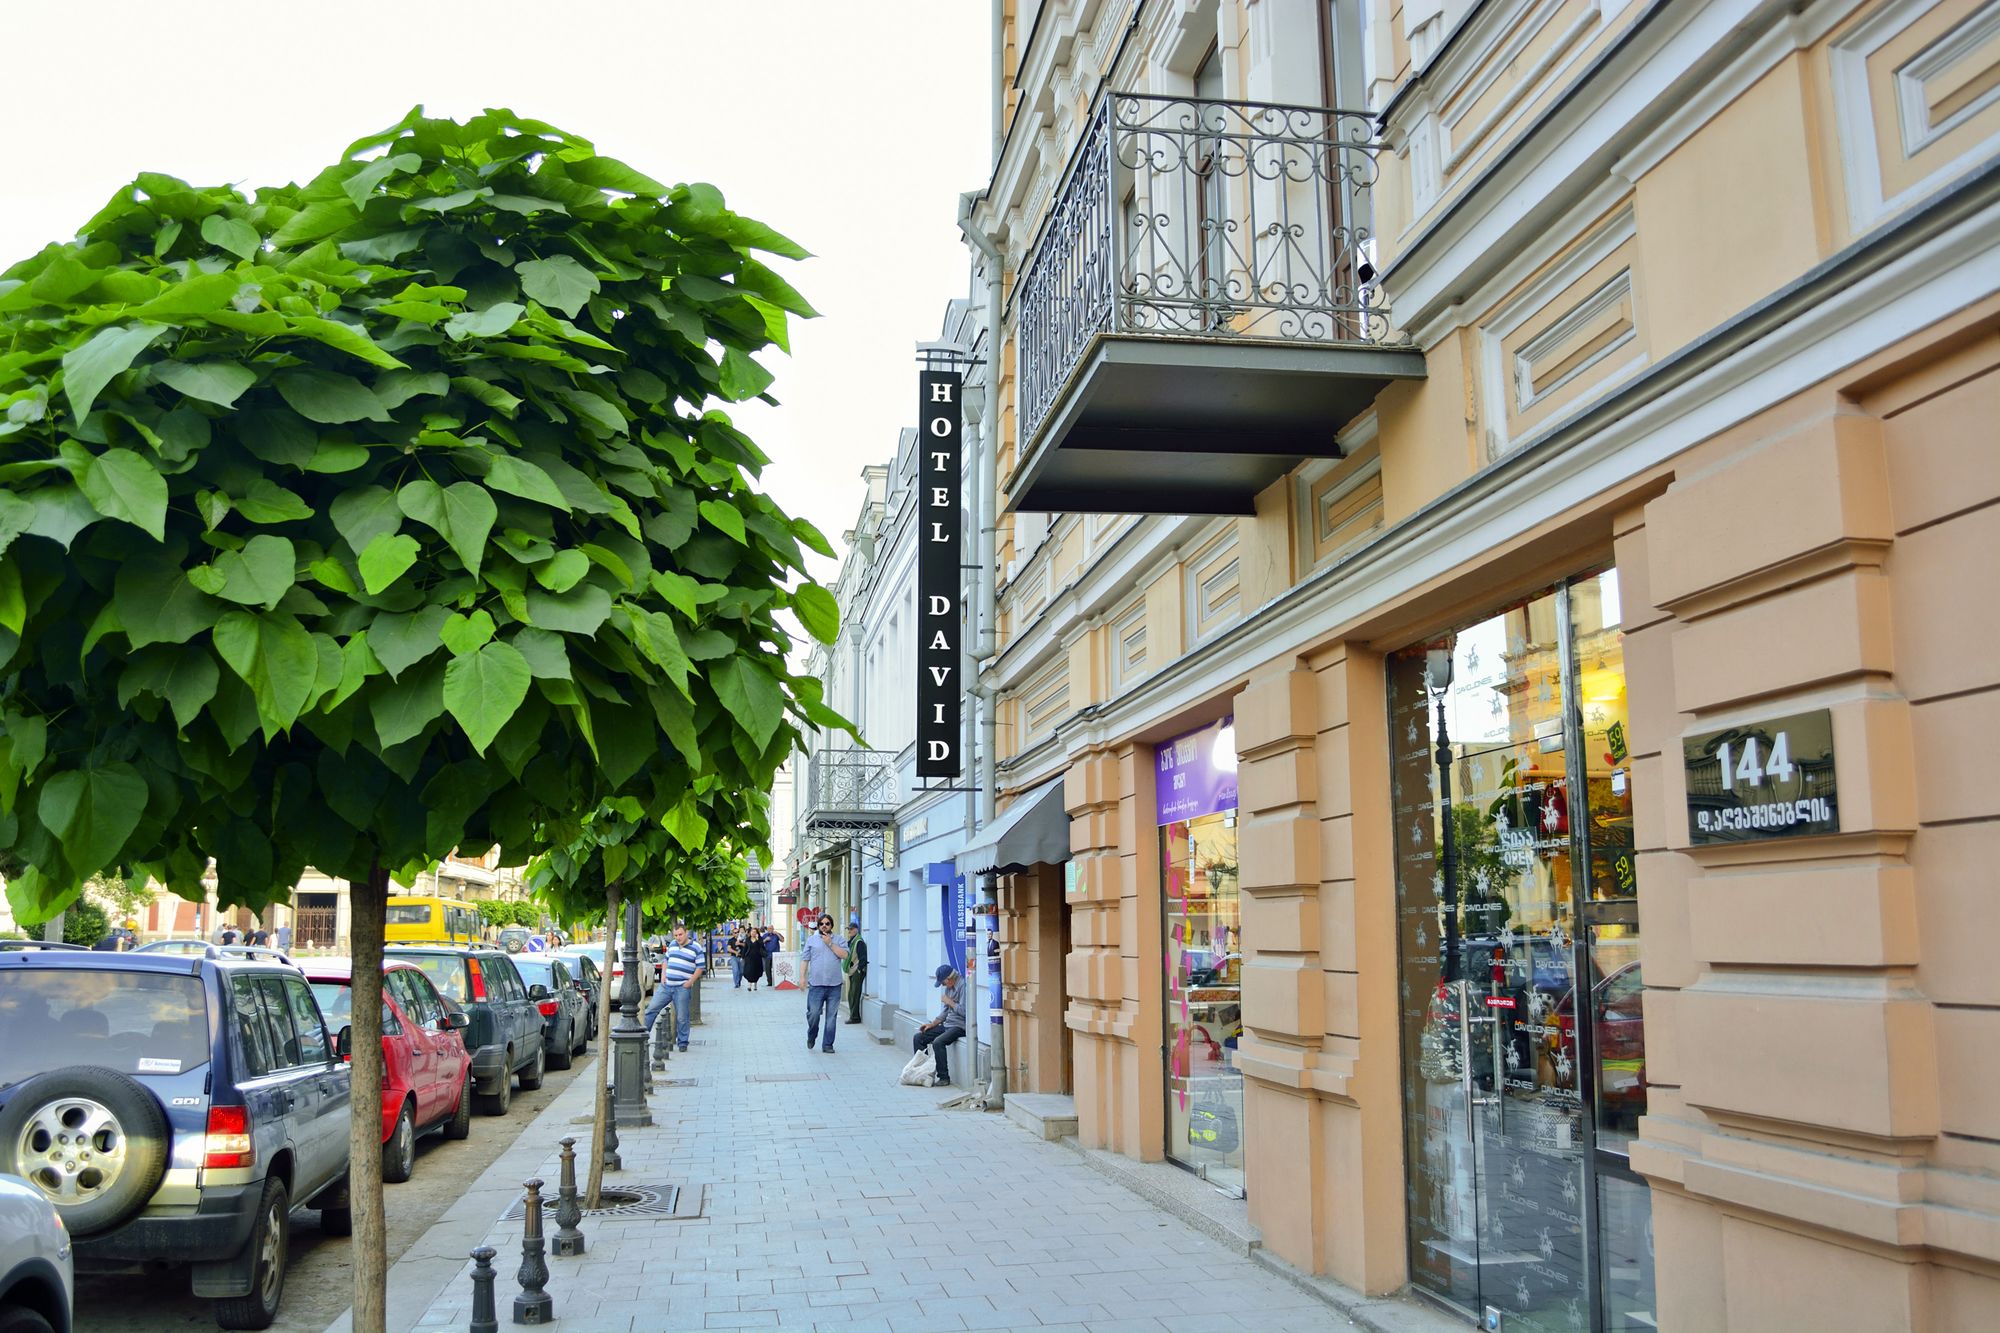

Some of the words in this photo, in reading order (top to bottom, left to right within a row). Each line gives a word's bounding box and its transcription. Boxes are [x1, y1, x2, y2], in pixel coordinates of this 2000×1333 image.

[930, 382, 952, 543] HOTEL
[927, 594, 952, 761] DAVID
[1610, 727, 1622, 750] 59
[1716, 731, 1793, 790] 144
[1697, 796, 1830, 832] დ.აღმაშენებლის
[1504, 850, 1534, 865] OPEN
[1615, 856, 1629, 880] 59
[957, 882, 965, 928] BASISBANK
[172, 1097, 200, 1105] GDI
